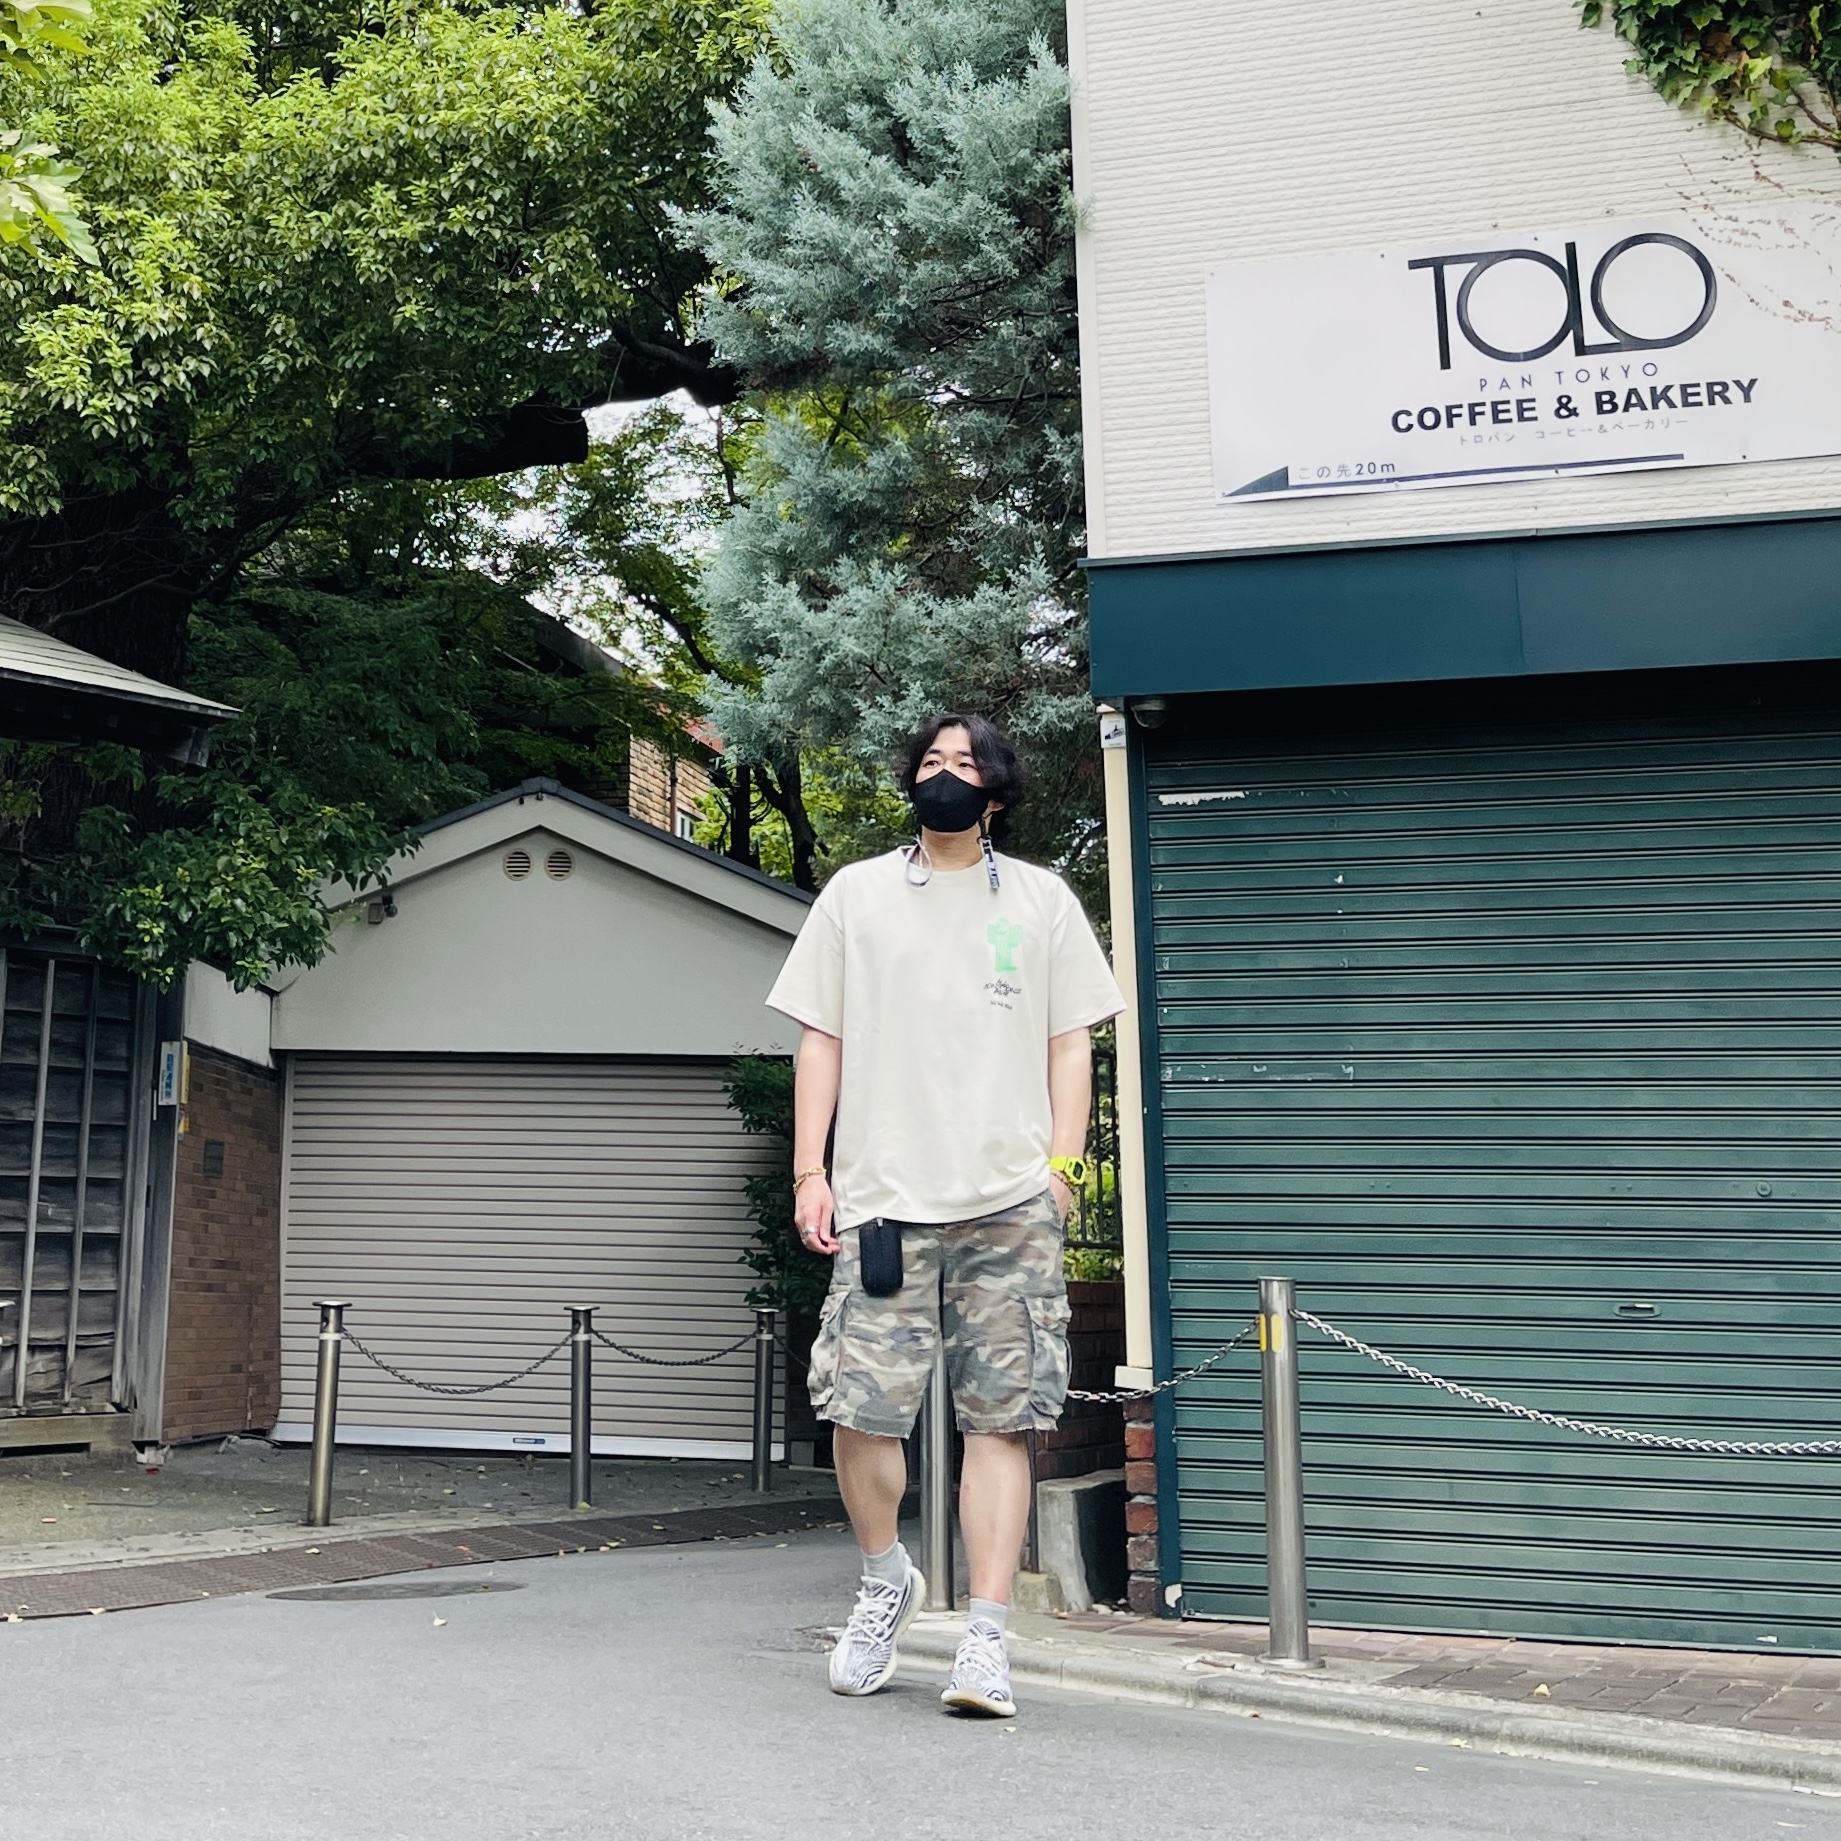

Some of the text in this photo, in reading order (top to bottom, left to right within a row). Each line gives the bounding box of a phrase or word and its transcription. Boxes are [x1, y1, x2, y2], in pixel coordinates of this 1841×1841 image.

[1408, 232, 1717, 370] TOLO
[1479, 362, 1658, 391] PAN TOKYO
[1391, 378, 1759, 433] COFFEE & BAKERY
